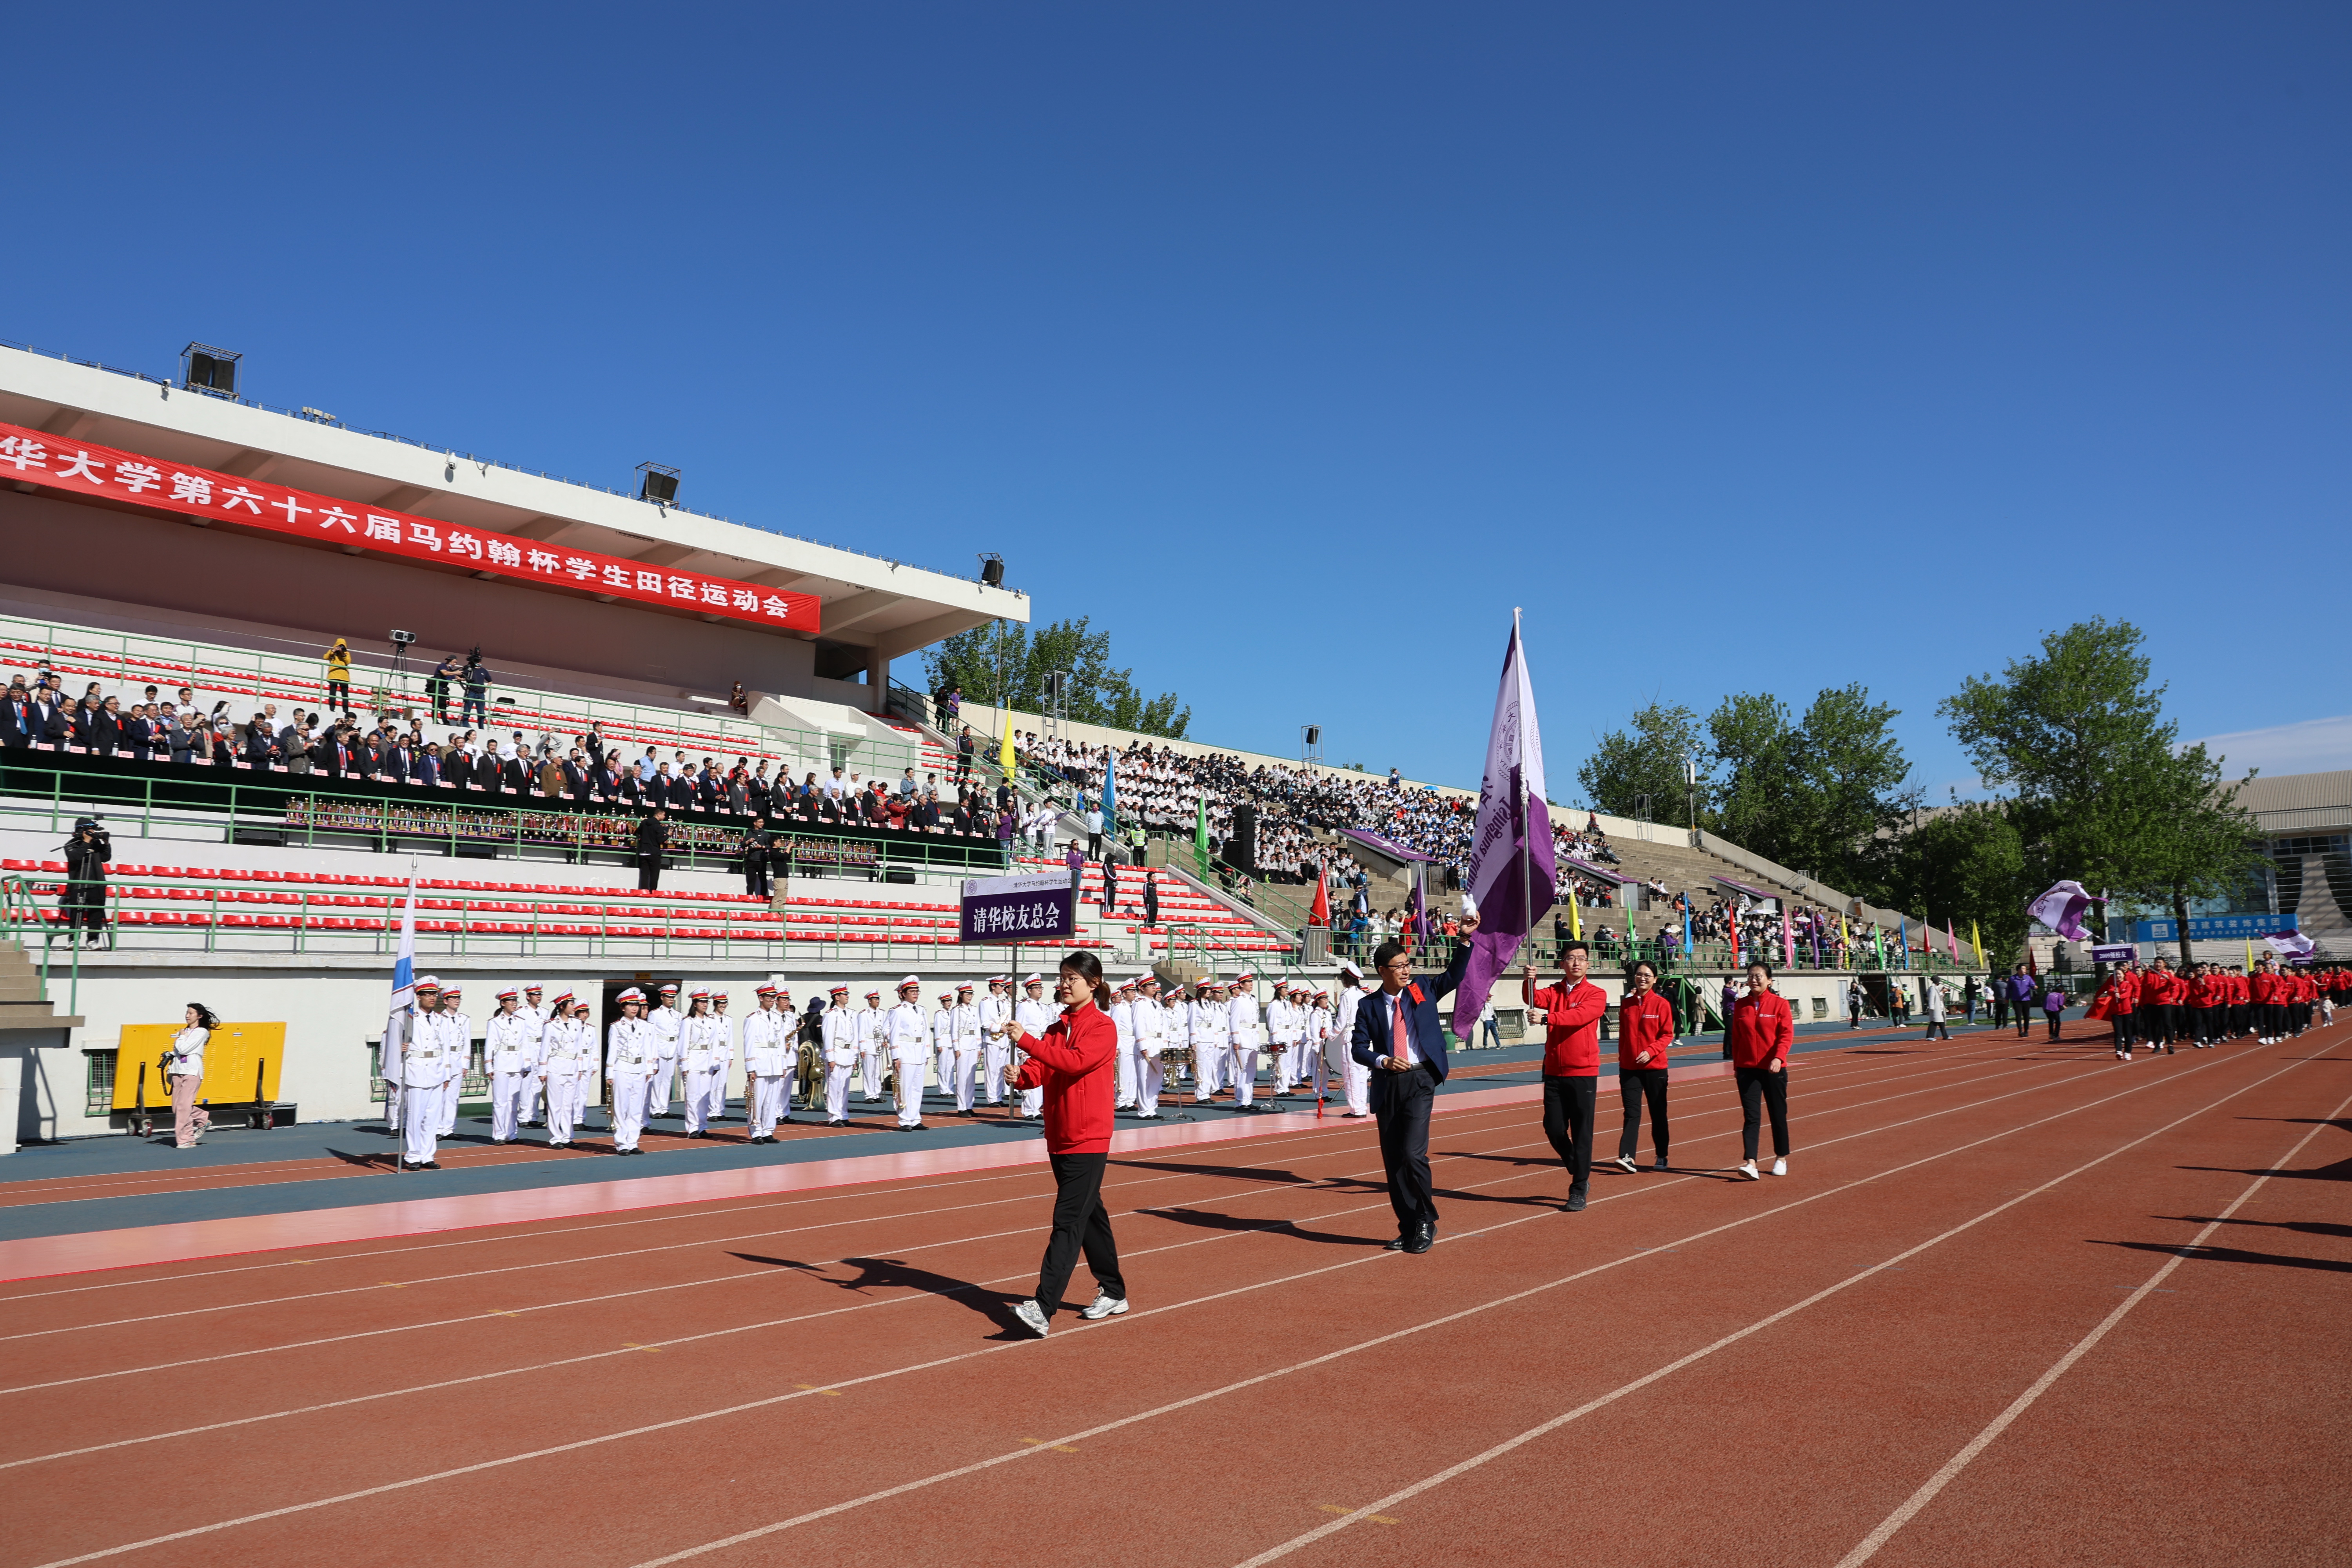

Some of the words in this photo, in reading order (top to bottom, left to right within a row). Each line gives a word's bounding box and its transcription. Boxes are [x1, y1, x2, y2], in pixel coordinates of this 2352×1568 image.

[0, 436, 788, 618] 华大学第六十六届马约翰杯学生田径运动会
[1013, 877, 1072, 888] 清华大学马约翰杯学生运动会
[973, 902, 1060, 933] 清华校友总会
[2174, 918, 2280, 929] 国建筑装饰集团
